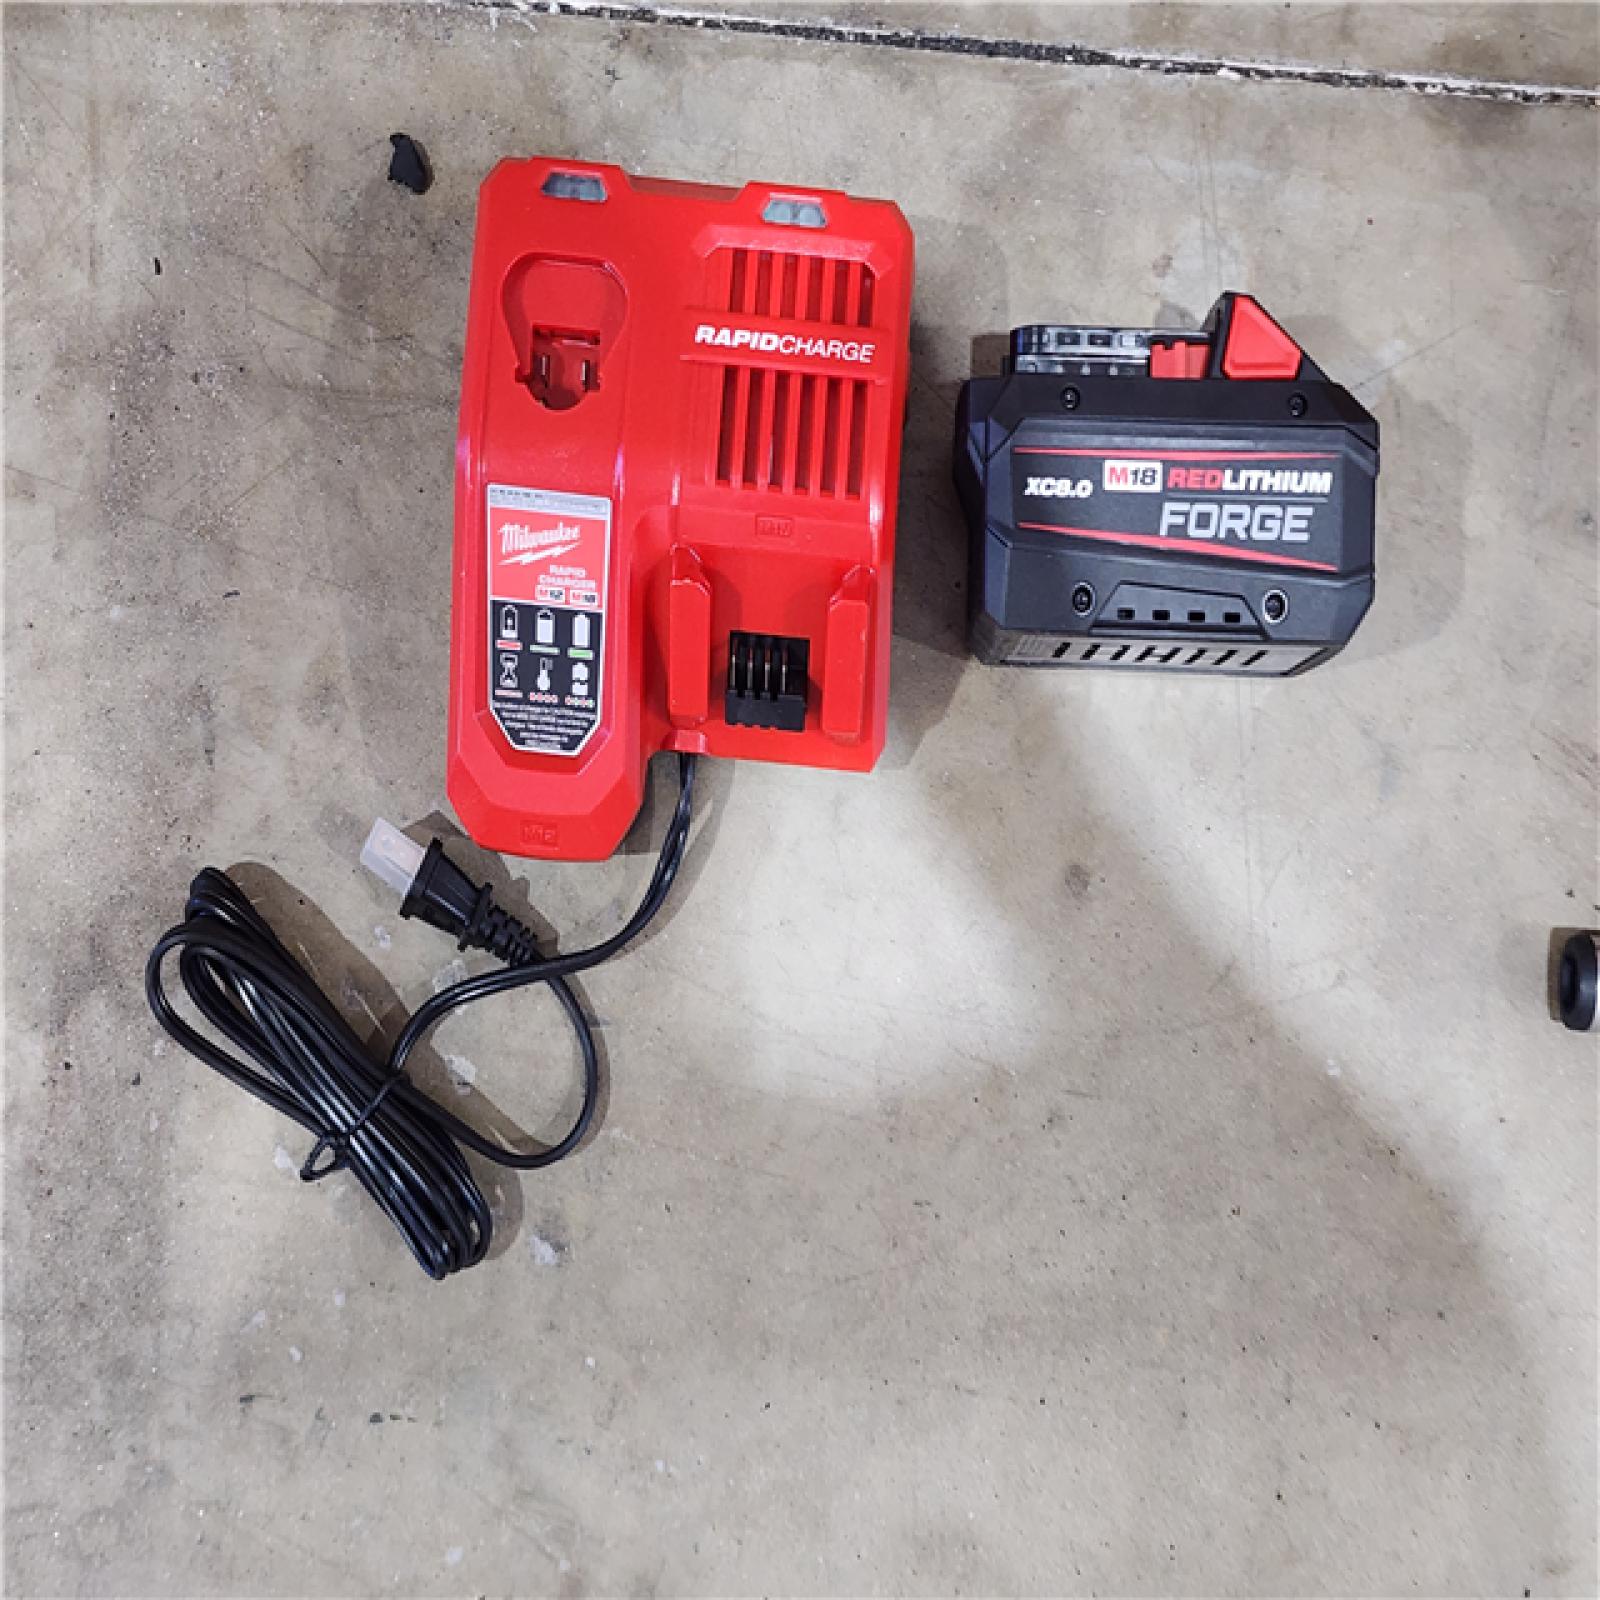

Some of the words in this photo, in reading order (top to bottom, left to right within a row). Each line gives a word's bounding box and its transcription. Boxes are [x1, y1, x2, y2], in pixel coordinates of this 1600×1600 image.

[1106, 466, 1158, 487] M18
[1167, 467, 1334, 494] REDLITHIUM
[1160, 501, 1314, 542] FORGE
